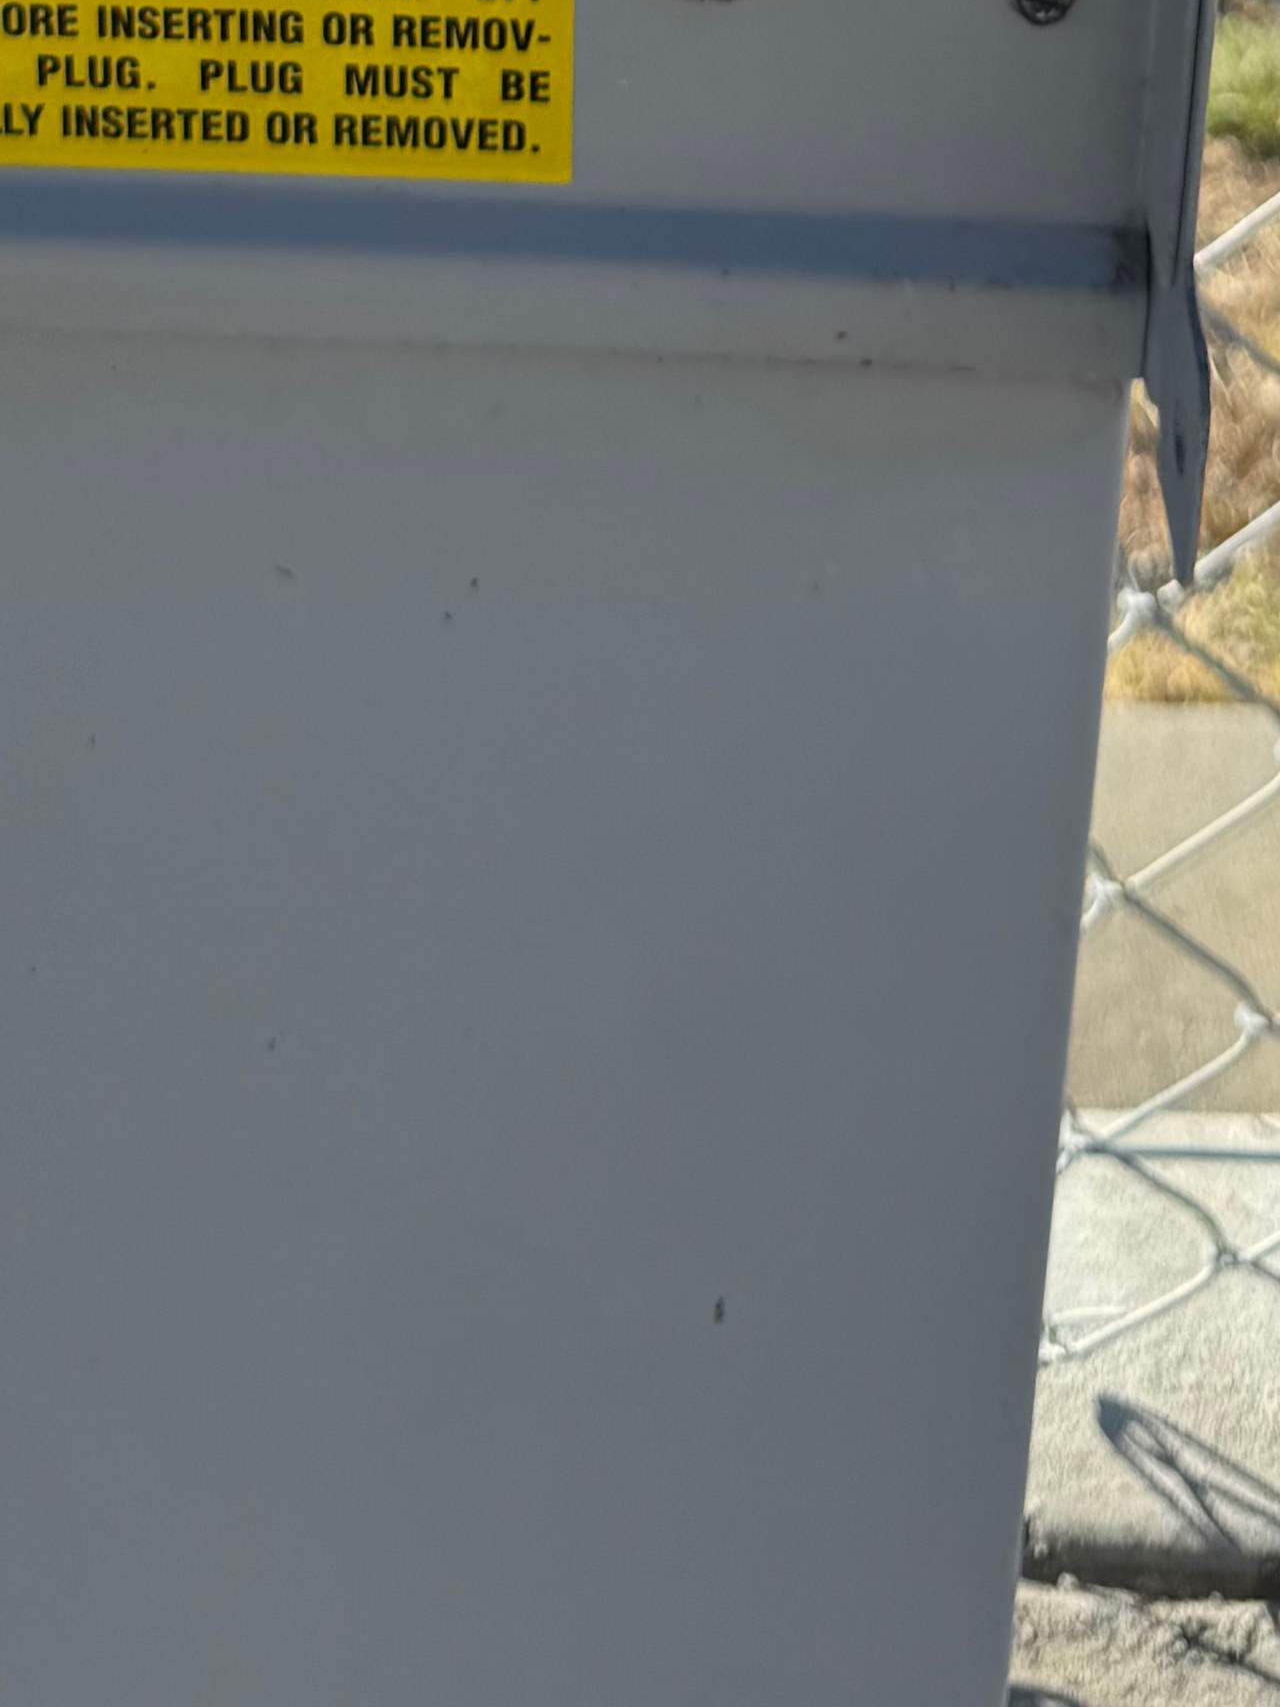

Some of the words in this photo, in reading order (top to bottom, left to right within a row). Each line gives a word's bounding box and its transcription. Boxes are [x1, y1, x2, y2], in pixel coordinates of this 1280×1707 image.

[97, 5, 304, 45] INSERTING
[322, 11, 374, 47] OR
[392, 14, 551, 53] REMOV-
[36, 54, 156, 91] PLUG.
[199, 59, 303, 95] PLUG
[344, 64, 459, 101] MUST
[500, 68, 551, 104] BE
[61, 105, 250, 143] INSERTED
[266, 111, 318, 146] OR
[333, 114, 540, 154] REMOVED.
